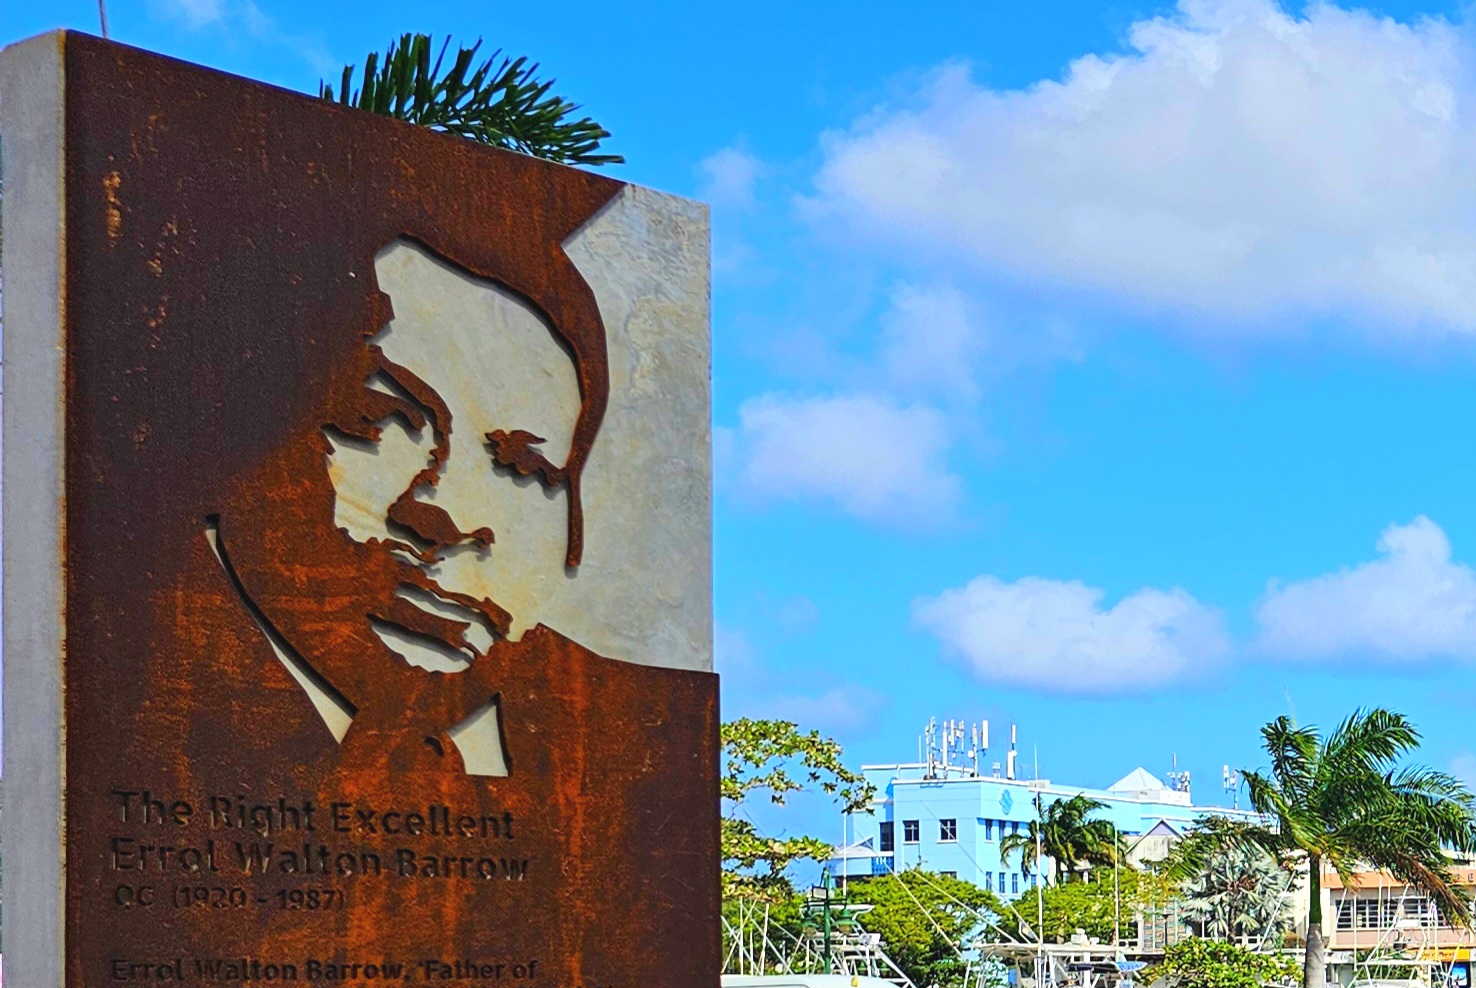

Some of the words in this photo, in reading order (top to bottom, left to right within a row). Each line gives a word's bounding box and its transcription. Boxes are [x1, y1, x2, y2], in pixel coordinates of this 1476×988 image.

[110, 790, 193, 826] The
[209, 795, 316, 838] Right
[331, 802, 515, 840] Excellent
[110, 837, 220, 872] Errol
[235, 842, 381, 876] Walton
[396, 848, 529, 880] Barrow
[115, 885, 154, 909] QC
[173, 885, 247, 909] (1920
[277, 888, 345, 910] 1987)
[112, 959, 184, 981] Errol
[196, 960, 297, 981] Walton
[512, 960, 538, 980] of
